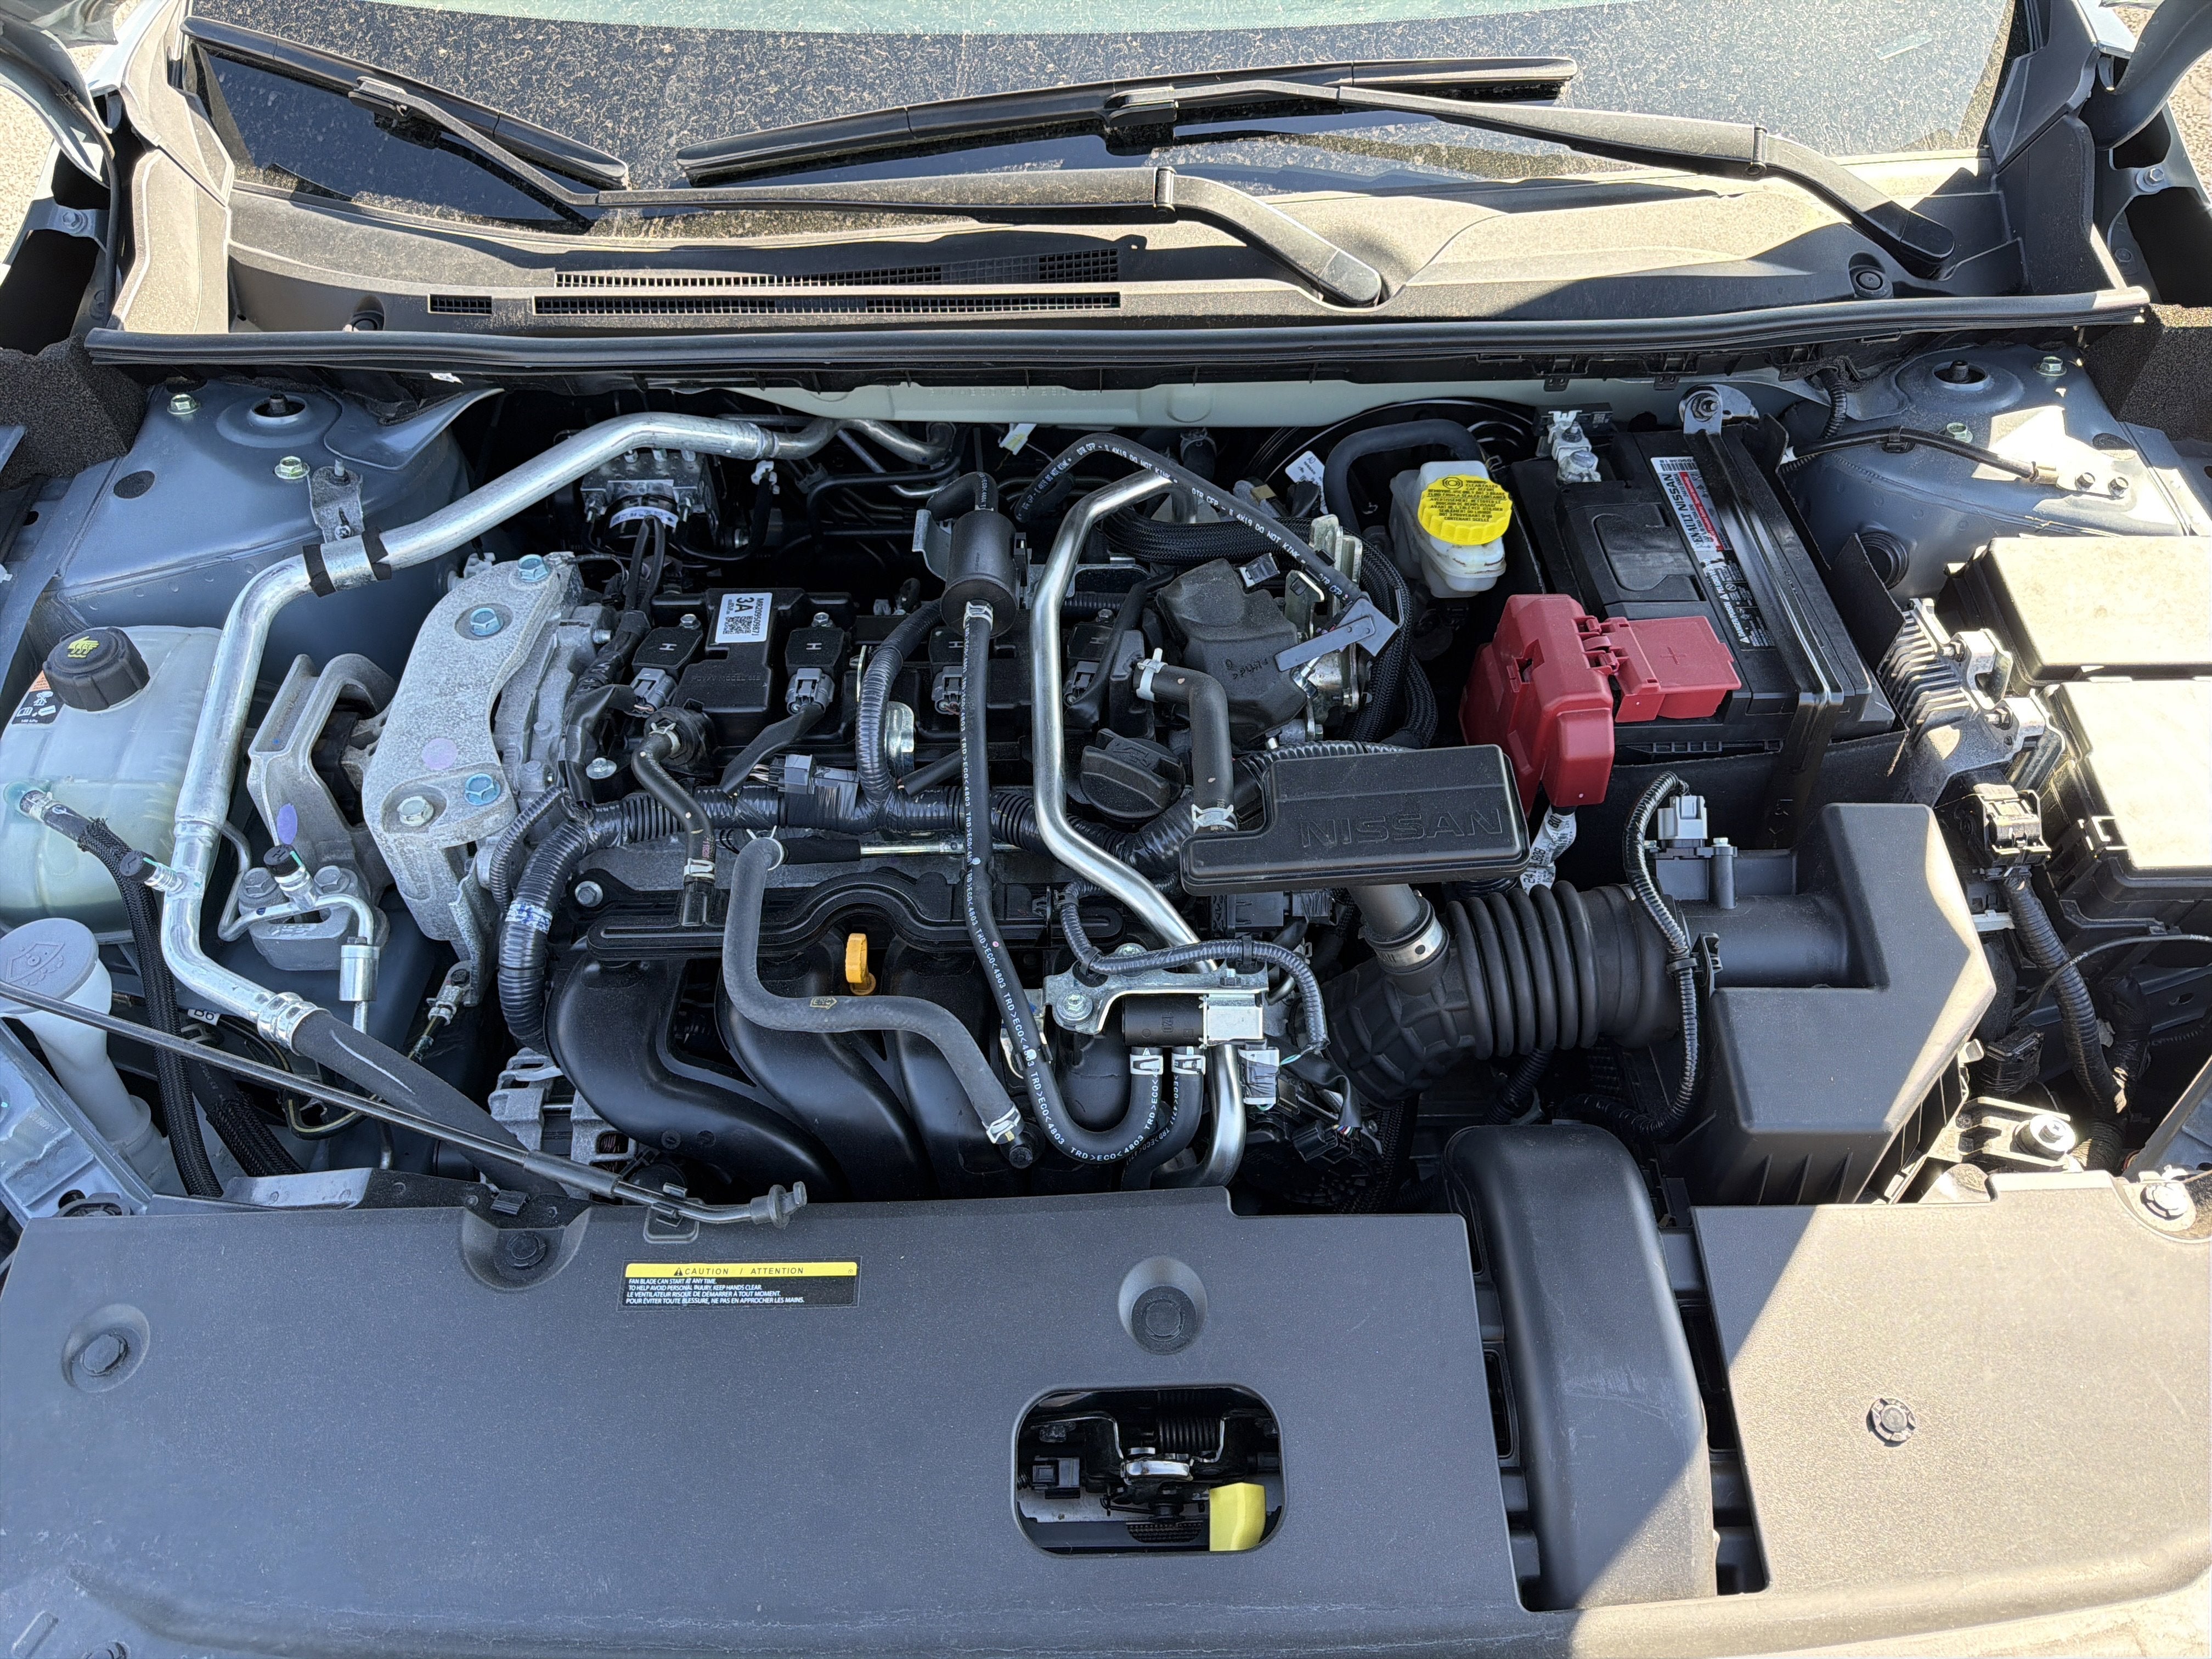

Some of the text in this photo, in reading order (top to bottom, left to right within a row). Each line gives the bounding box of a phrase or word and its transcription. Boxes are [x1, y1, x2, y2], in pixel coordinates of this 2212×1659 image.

[1661, 473, 1689, 511] NISSAN
[1236, 513, 1252, 527] 4X19
[1255, 523, 1265, 534] DO
[1267, 532, 1282, 544] NOT
[1282, 542, 1300, 559] KINK
[735, 597, 755, 613] 3A
[1301, 809, 1502, 848] NISSAN
[961, 736, 970, 808] TRD>ECO<4803
[966, 868, 978, 926] TRD>ECO<4803
[976, 928, 1007, 989] TRD>ECO<4803
[1029, 1071, 1065, 1146] TRD>ECO<4803
[1070, 1135, 1144, 1162] TRD>ECO<4803
